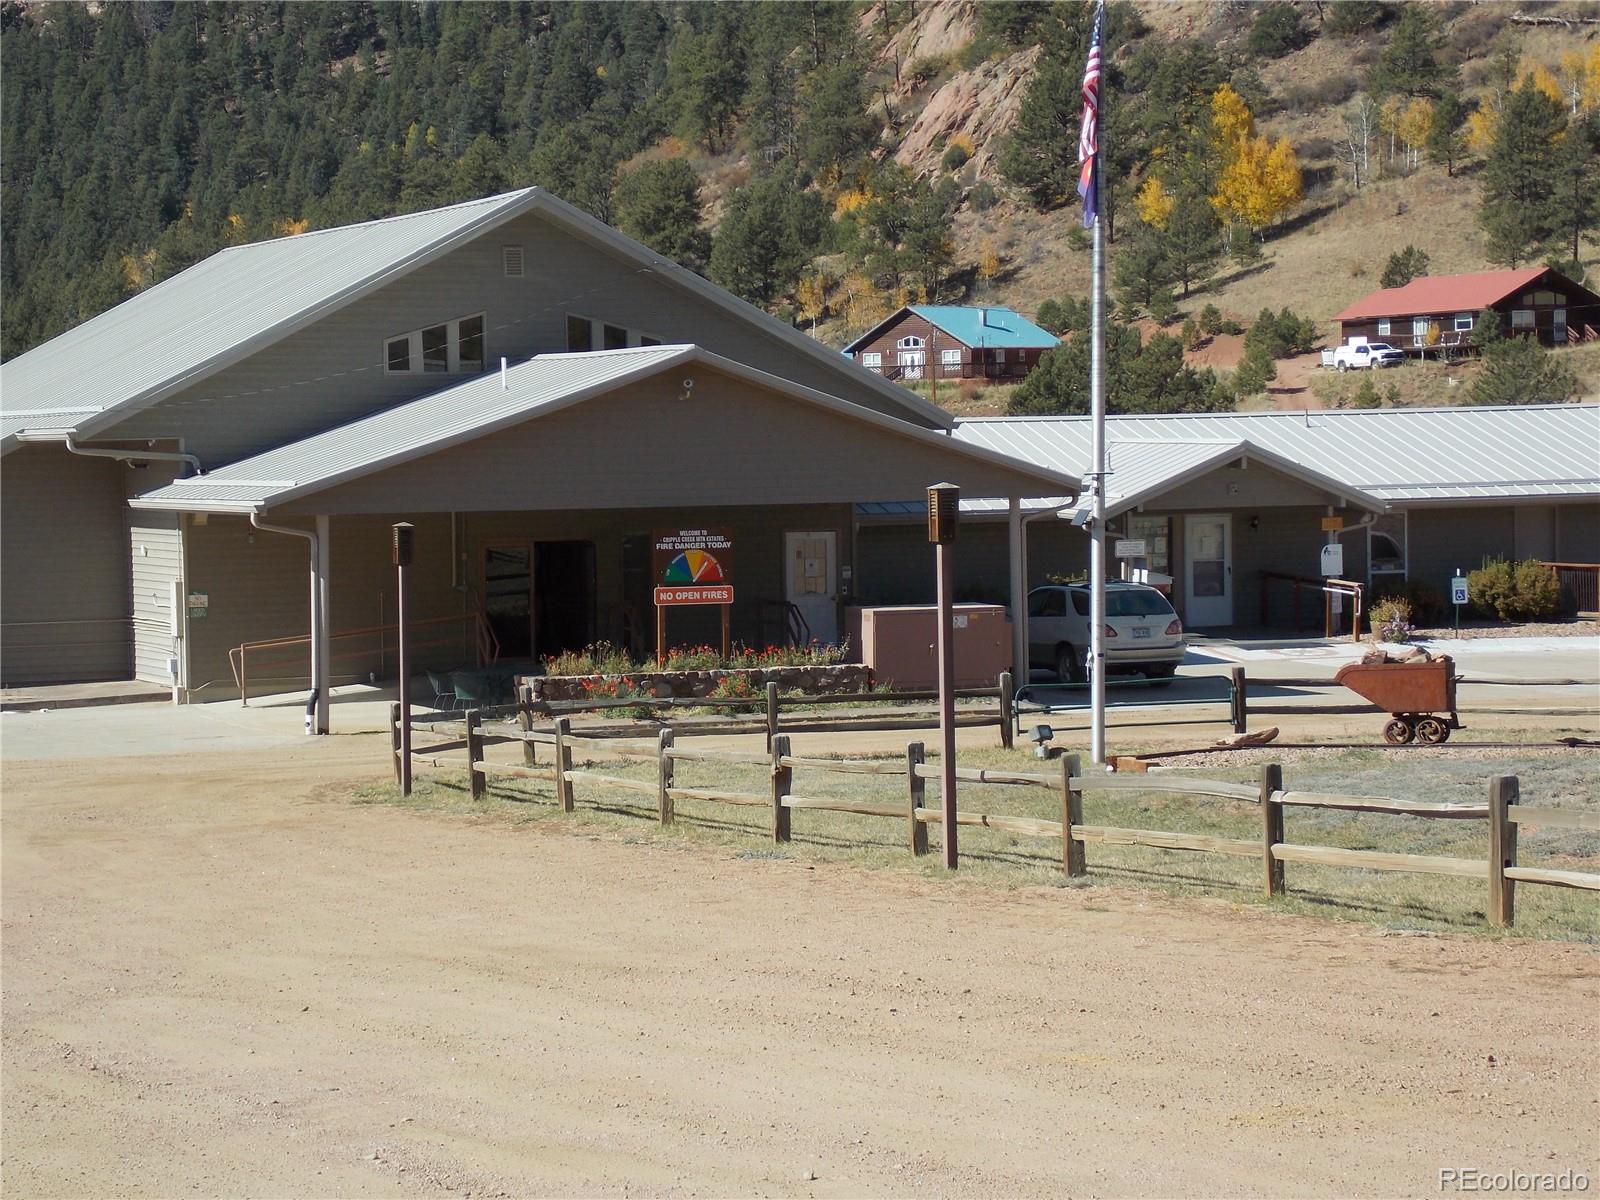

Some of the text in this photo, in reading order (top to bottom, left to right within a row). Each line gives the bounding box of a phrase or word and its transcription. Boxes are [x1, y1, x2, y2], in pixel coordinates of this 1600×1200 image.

[707, 541, 732, 549] TODAY
[660, 590, 728, 601] NO OPEN FIRES
